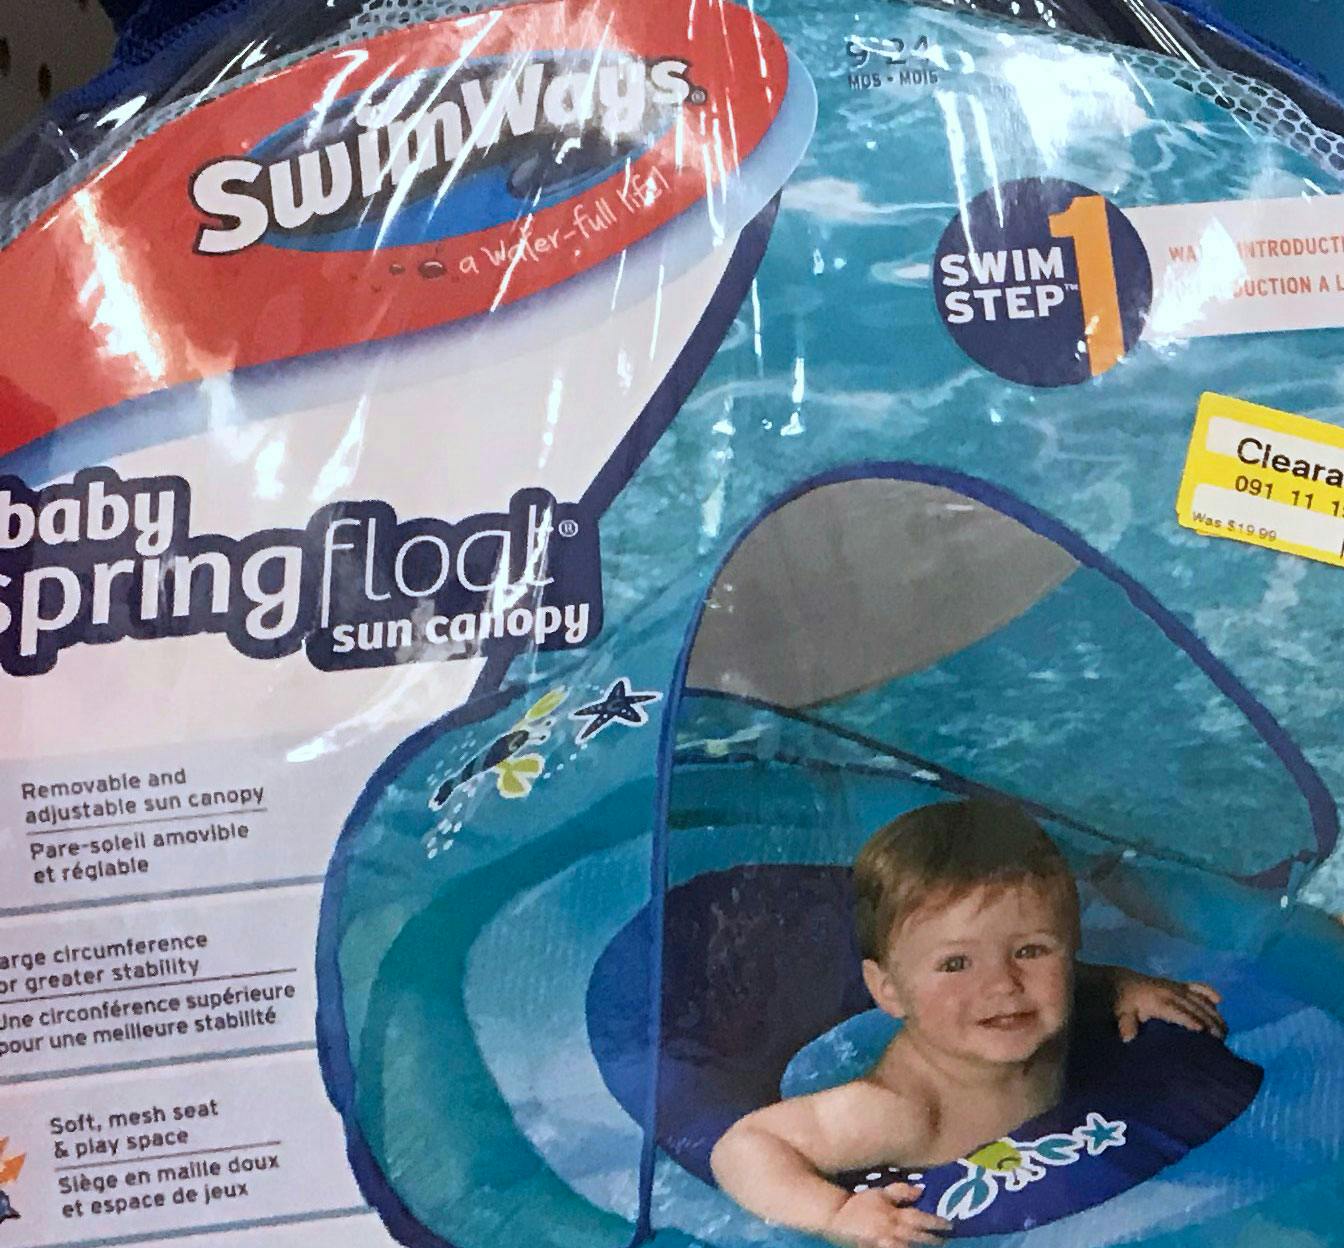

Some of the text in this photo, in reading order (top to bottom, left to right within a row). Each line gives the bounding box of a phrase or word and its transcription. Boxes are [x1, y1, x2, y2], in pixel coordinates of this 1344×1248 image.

[940, 246, 1065, 287] SWIM
[1318, 278, 1330, 292] A
[1234, 475, 1274, 500] 091
[1291, 490, 1314, 510] 11
[0, 485, 176, 555] baby
[332, 601, 589, 654] sun canopy
[21, 768, 187, 800] Removable and
[25, 786, 264, 825] adjustable sun canopy
[30, 822, 249, 860] Pare-soleil amovible
[33, 857, 149, 884] et réglable
